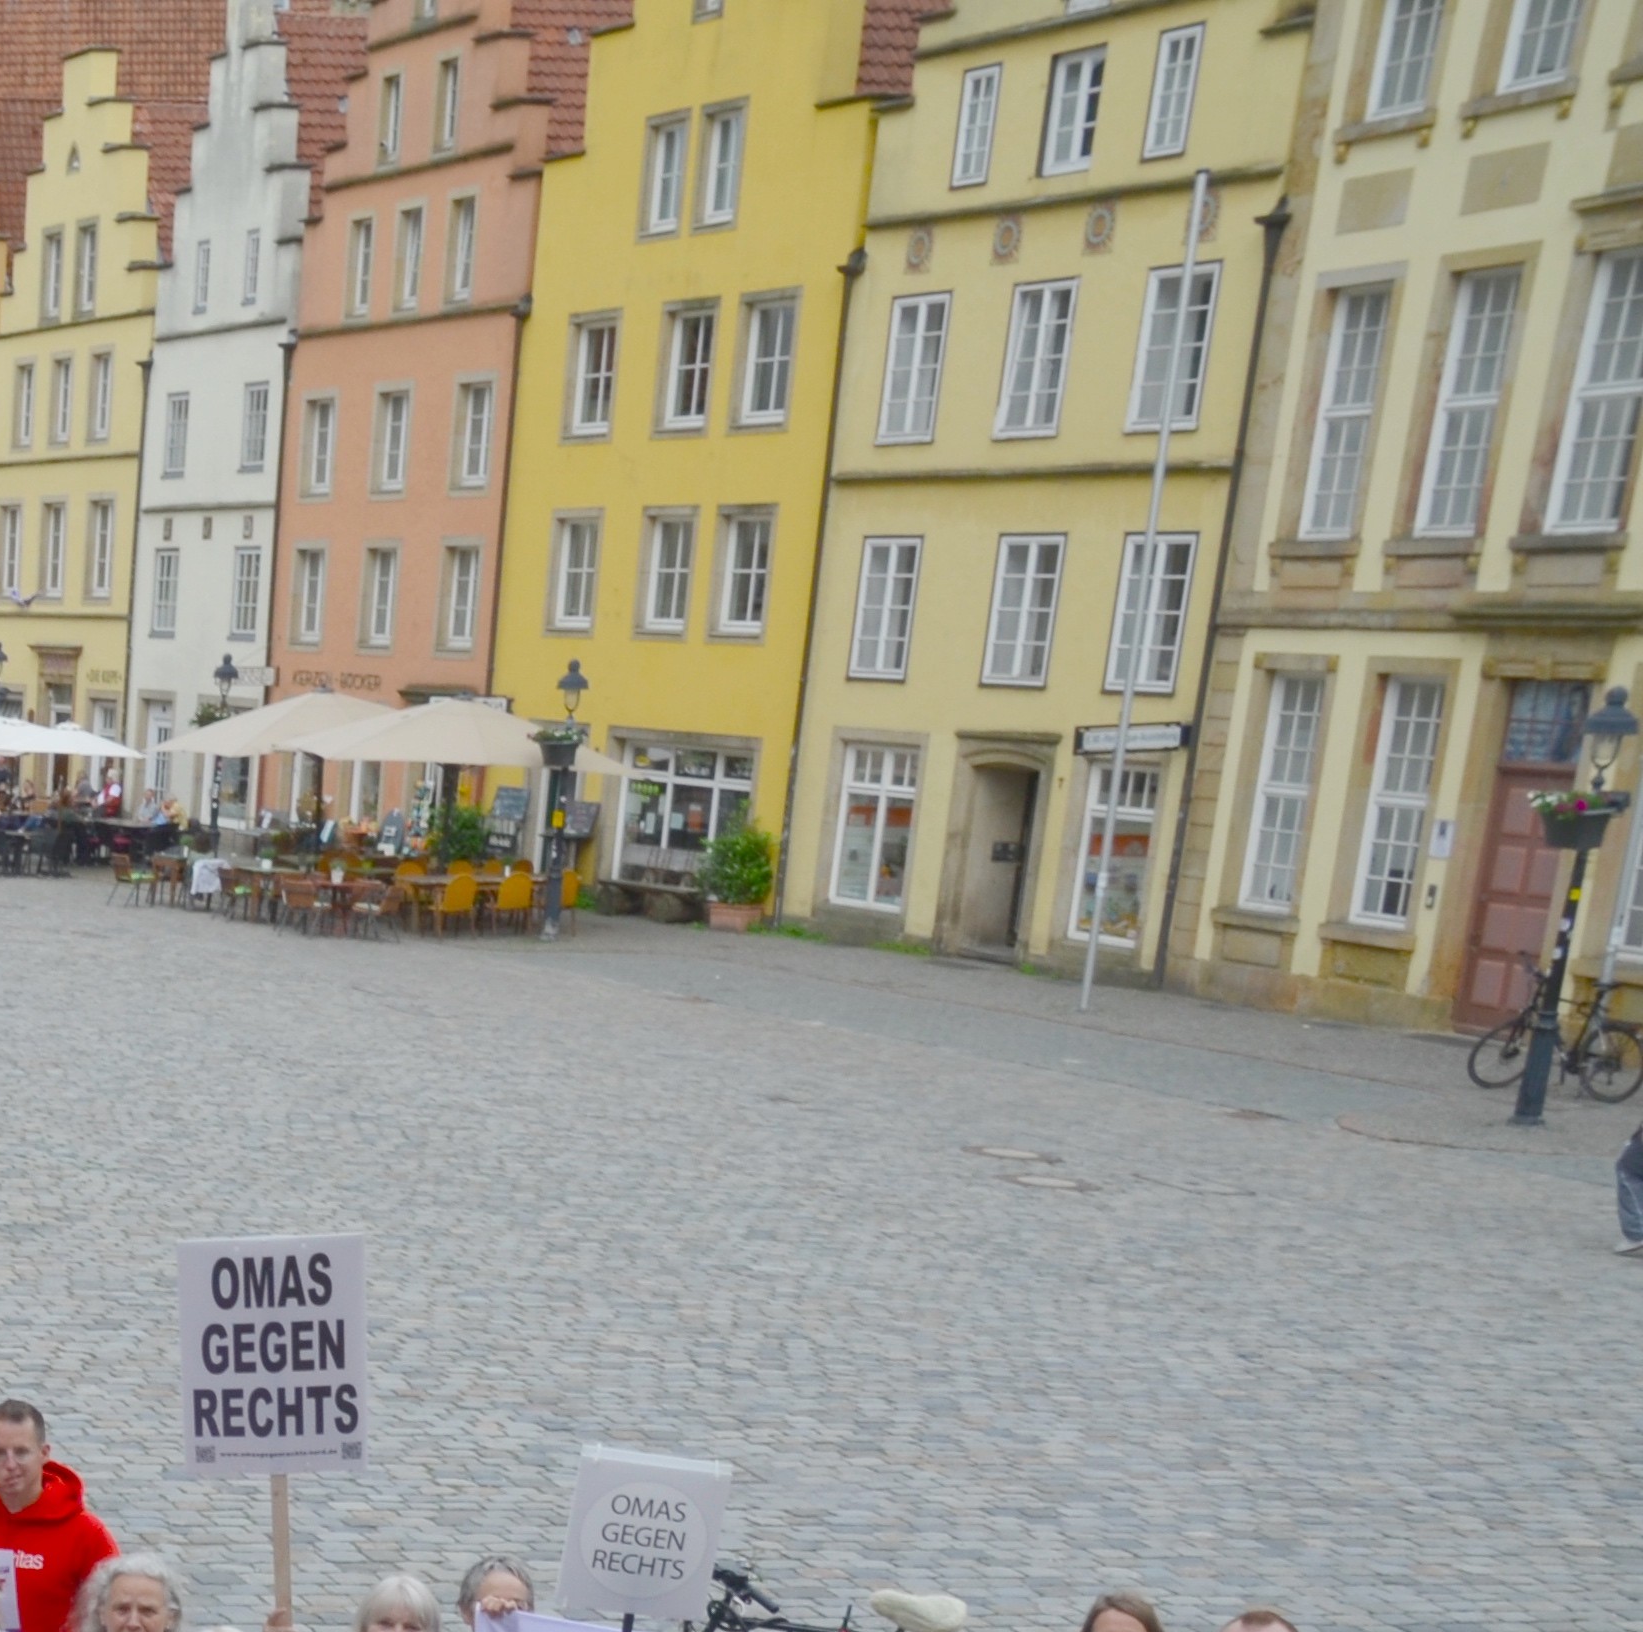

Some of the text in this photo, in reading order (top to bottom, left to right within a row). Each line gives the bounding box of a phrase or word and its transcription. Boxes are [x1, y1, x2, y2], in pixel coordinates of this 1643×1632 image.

[211, 1253, 333, 1310] OMAS
[201, 1319, 346, 1375] GEGEN
[193, 1384, 359, 1438] RECHTS
[611, 1494, 686, 1523] OMAS
[601, 1522, 686, 1552] GEGEN
[592, 1549, 685, 1581] RECHTS
